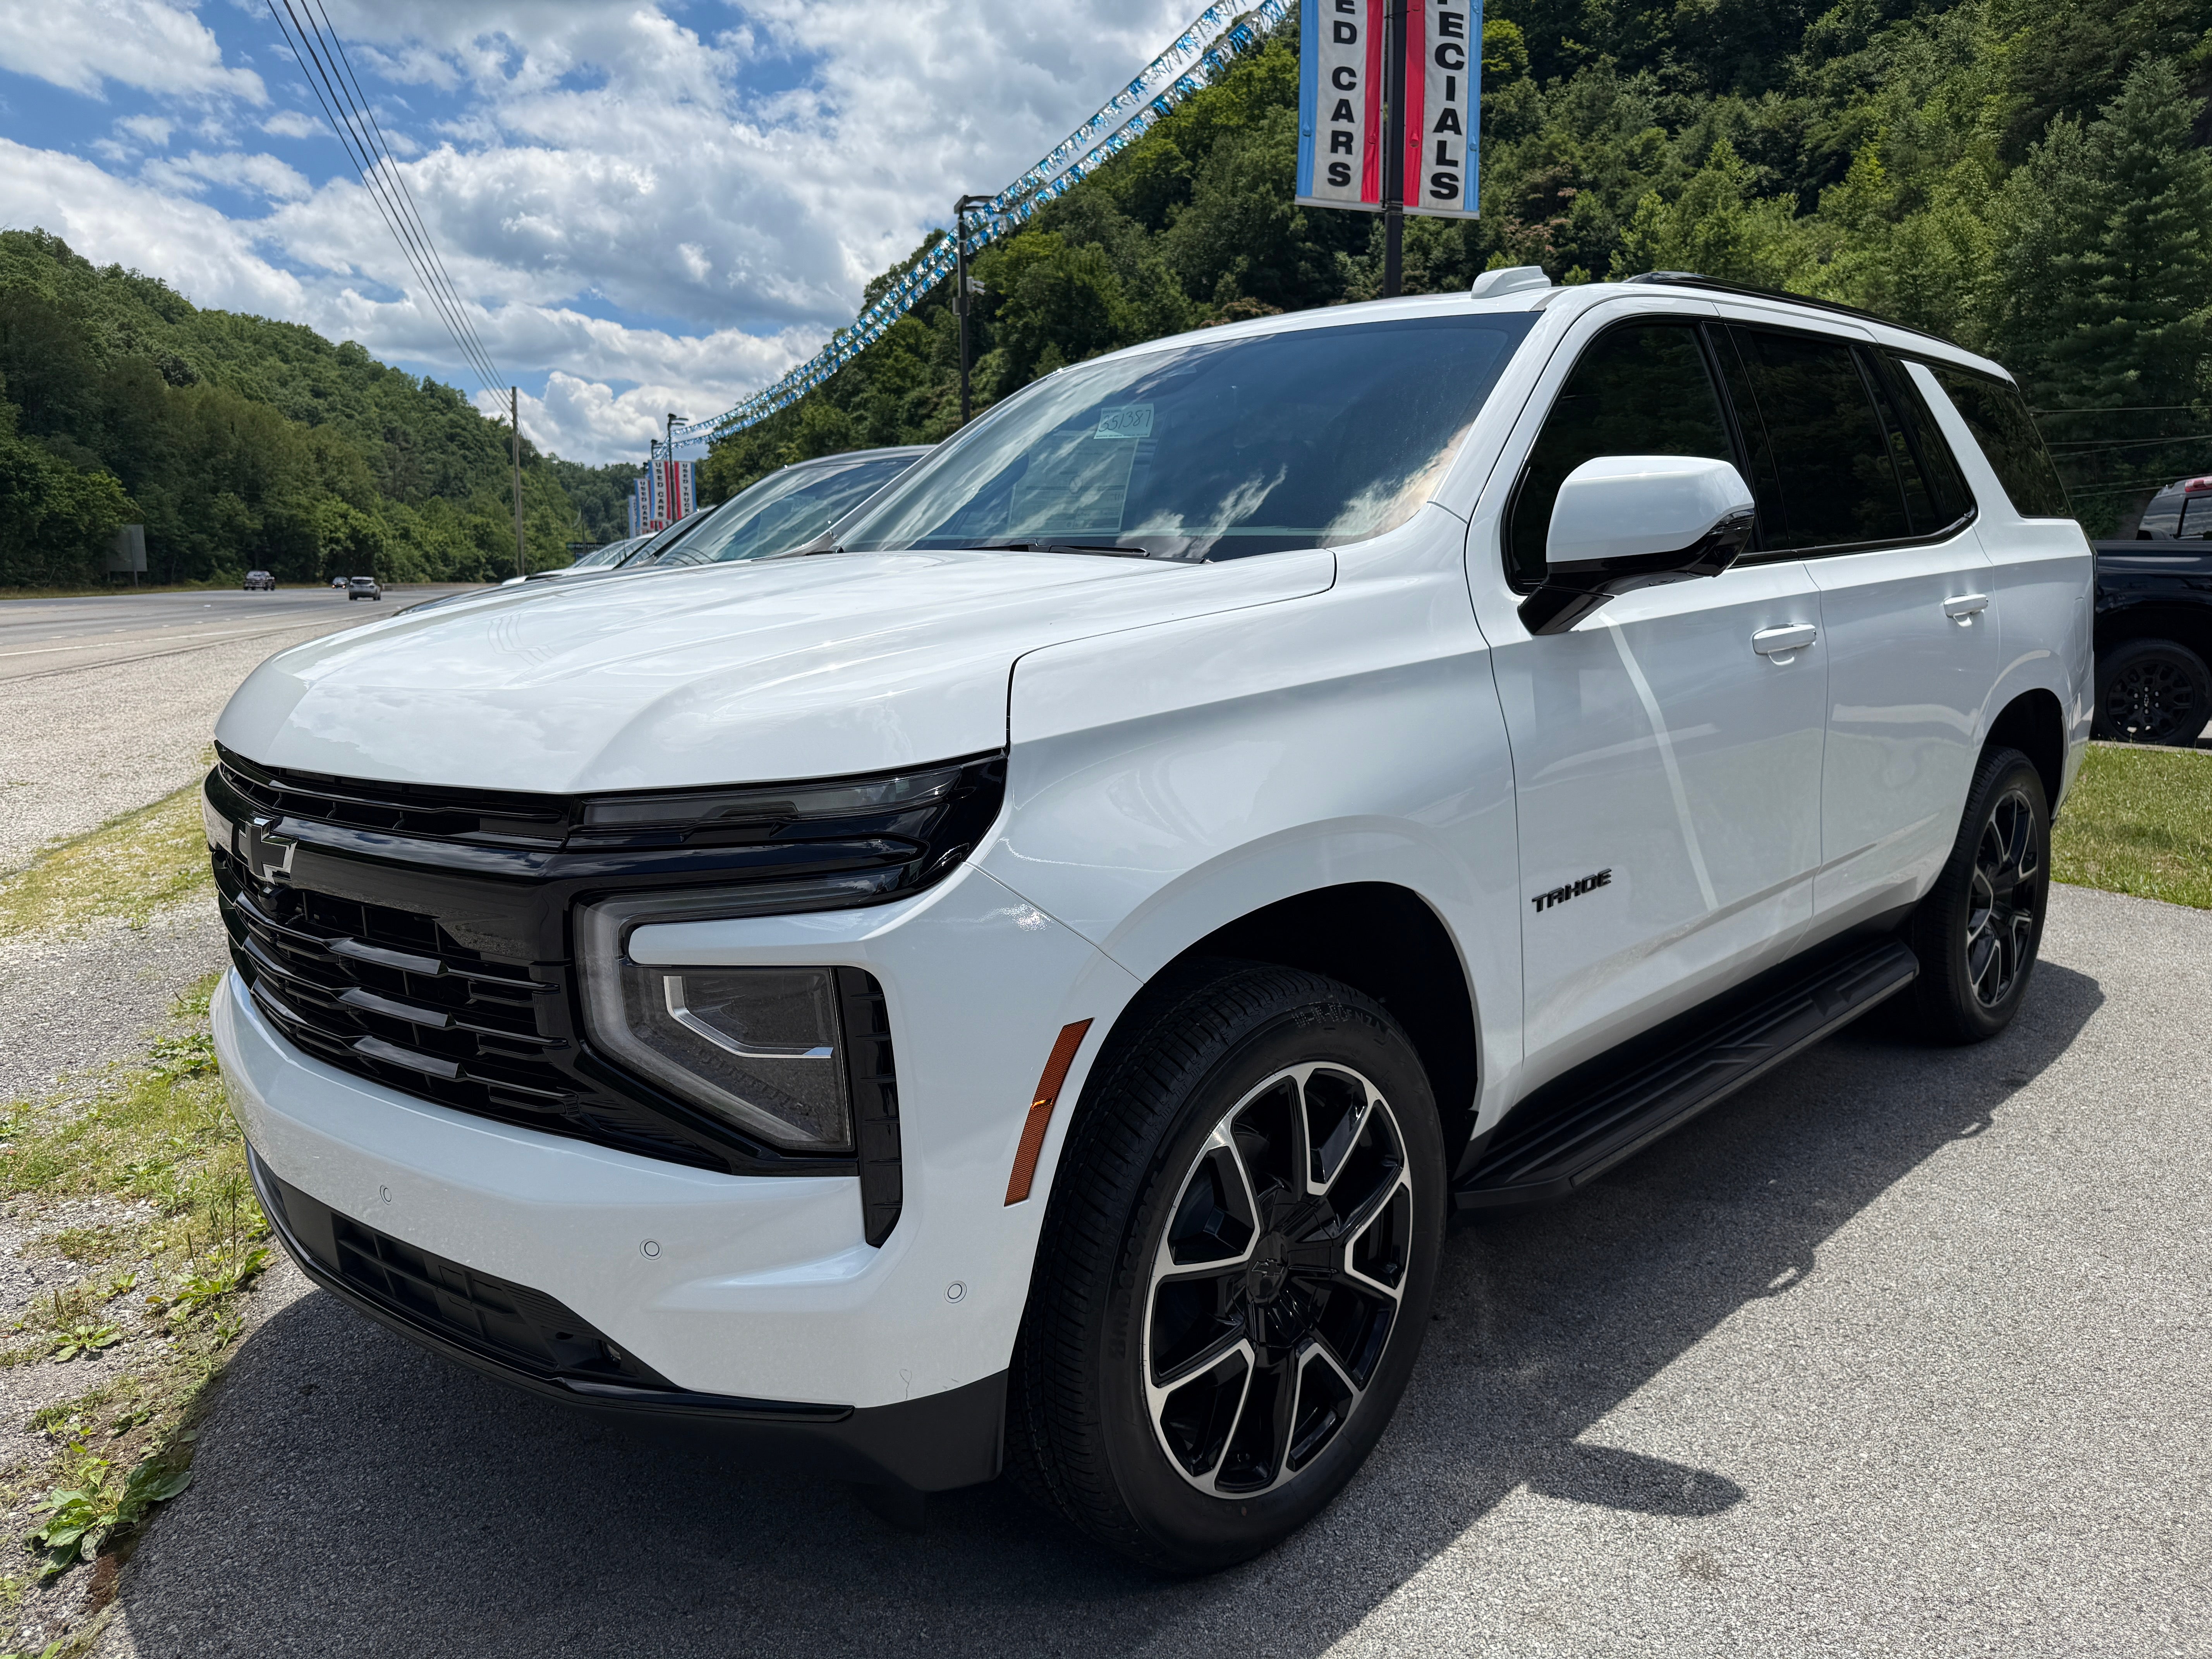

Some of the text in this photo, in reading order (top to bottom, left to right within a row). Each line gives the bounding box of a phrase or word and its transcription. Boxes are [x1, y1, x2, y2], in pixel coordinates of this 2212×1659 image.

[1327, 66, 1357, 187] CARS
[1429, 0, 1465, 200] ECIALS
[655, 462, 664, 488] USED
[1532, 868, 1612, 912] TAHOE
